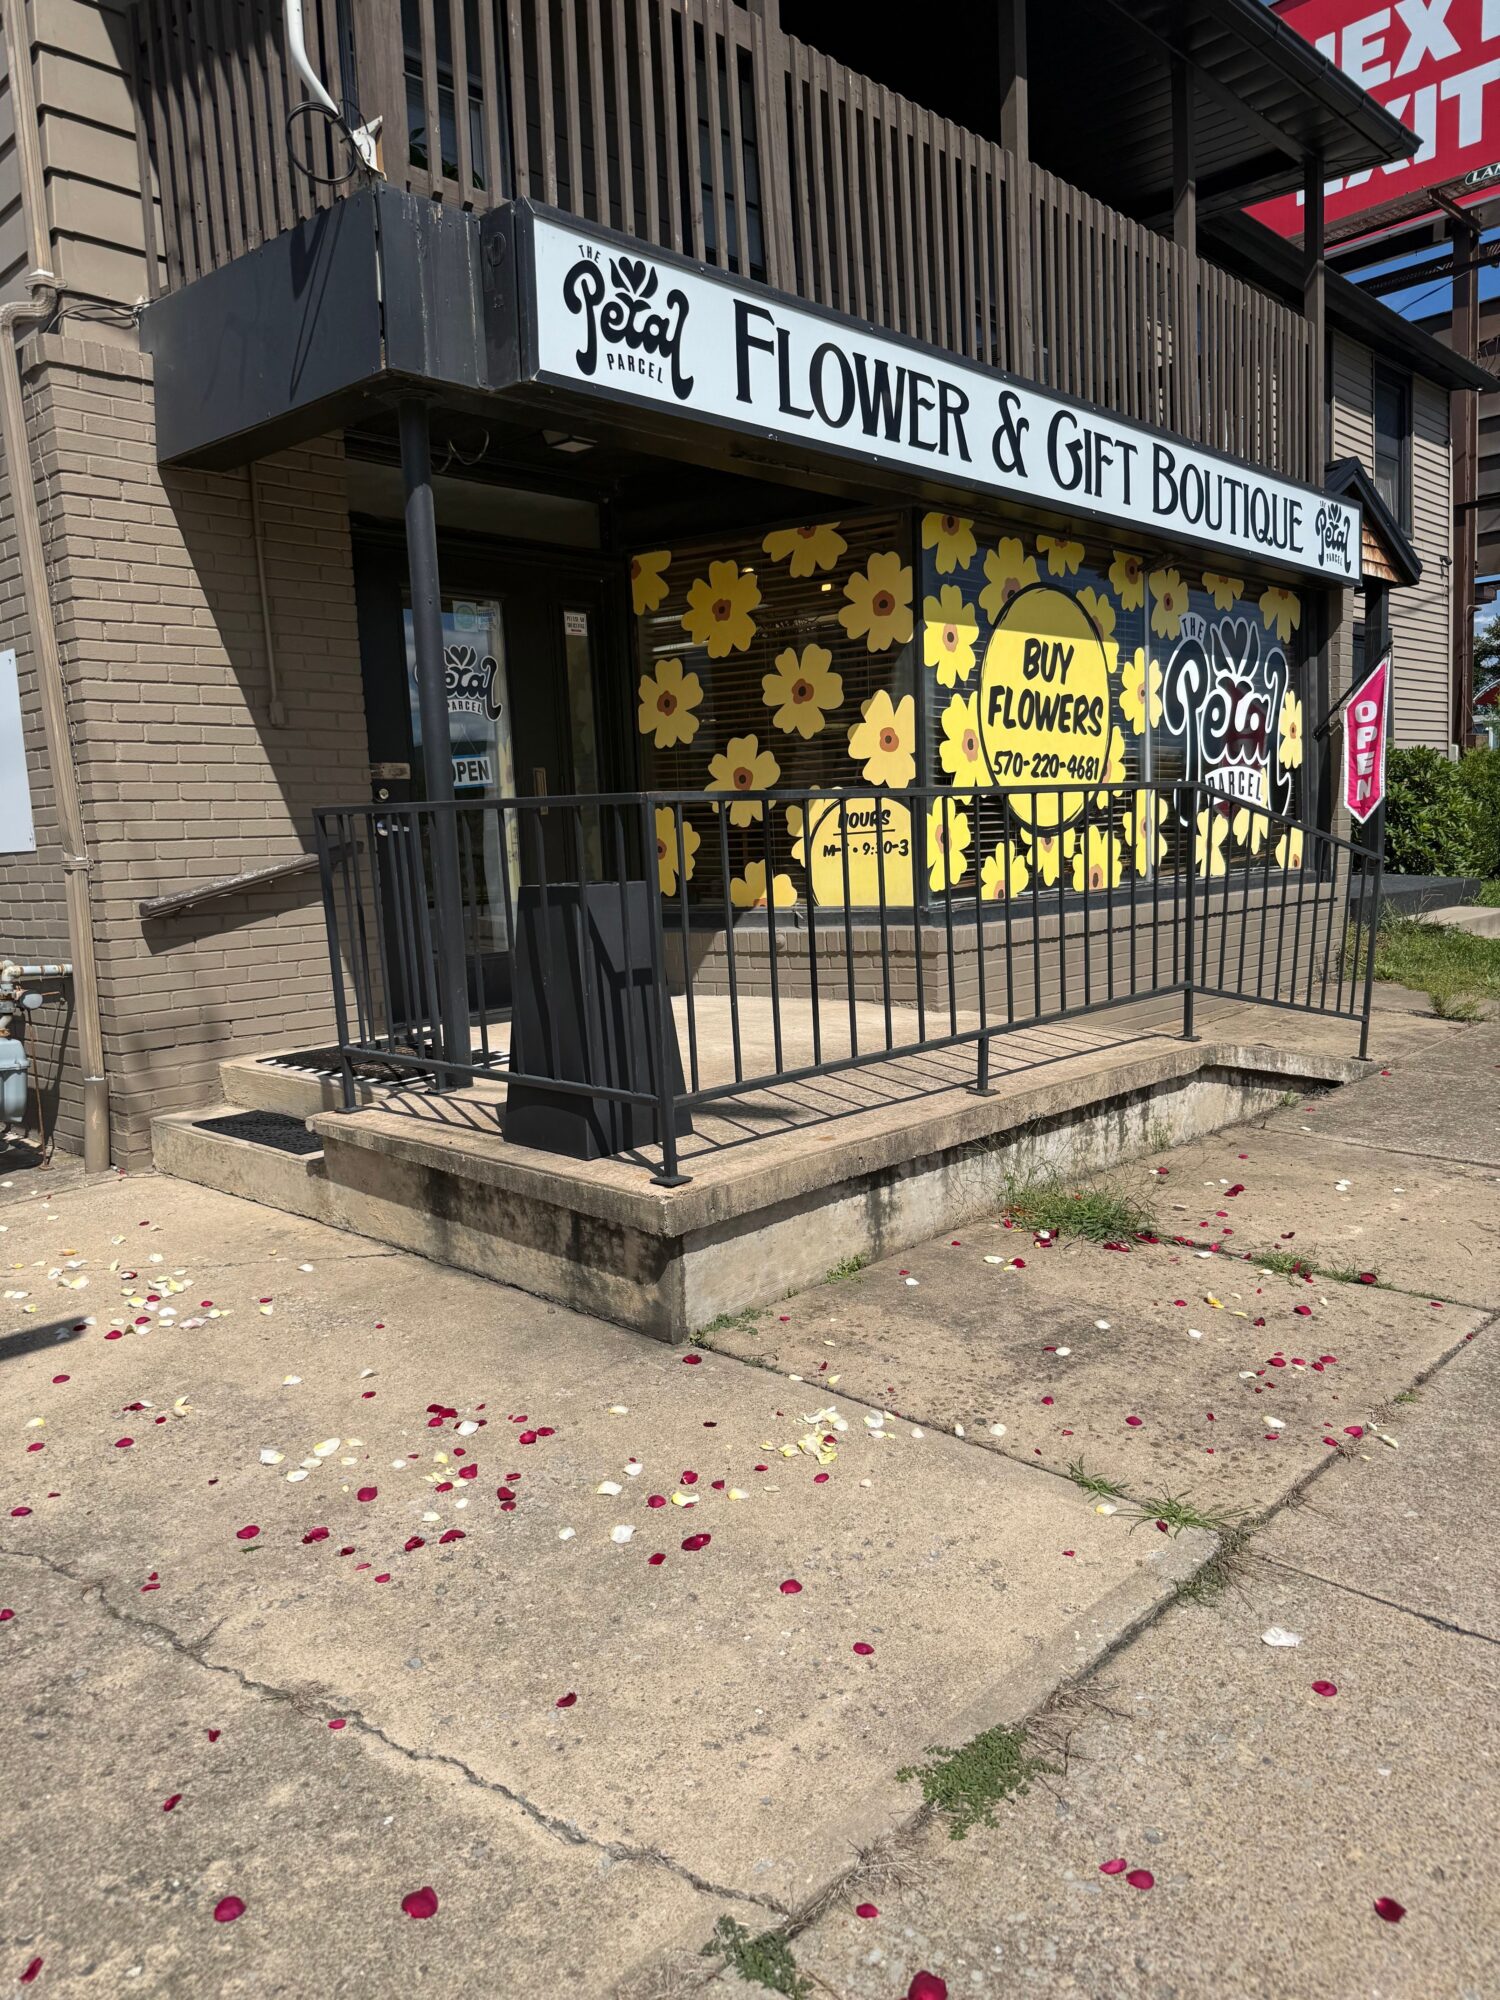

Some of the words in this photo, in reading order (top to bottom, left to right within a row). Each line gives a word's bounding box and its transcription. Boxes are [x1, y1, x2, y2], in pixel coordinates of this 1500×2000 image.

[1315, 0, 1500, 90] EX
[578, 244, 601, 264] THE
[563, 259, 694, 400] Petal
[606, 353, 663, 384] PARCEL
[733, 298, 972, 462] FLOWER
[992, 390, 1029, 478] &
[1047, 409, 1138, 505] GIFT
[1153, 442, 1303, 554] BOUTIQUE
[1315, 508, 1351, 574] Petal
[1181, 616, 1205, 641] THE
[1023, 637, 1074, 685] BUY
[448, 700, 482, 713] ARCEL
[988, 685, 1103, 737] FLOWERS
[1163, 637, 1291, 827] Petal
[1355, 700, 1378, 802] OPEN
[452, 759, 490, 783] PEN
[993, 750, 1100, 781] 570-220-4681
[823, 843, 849, 857] M-
[863, 839, 909, 856] 9:0-3
